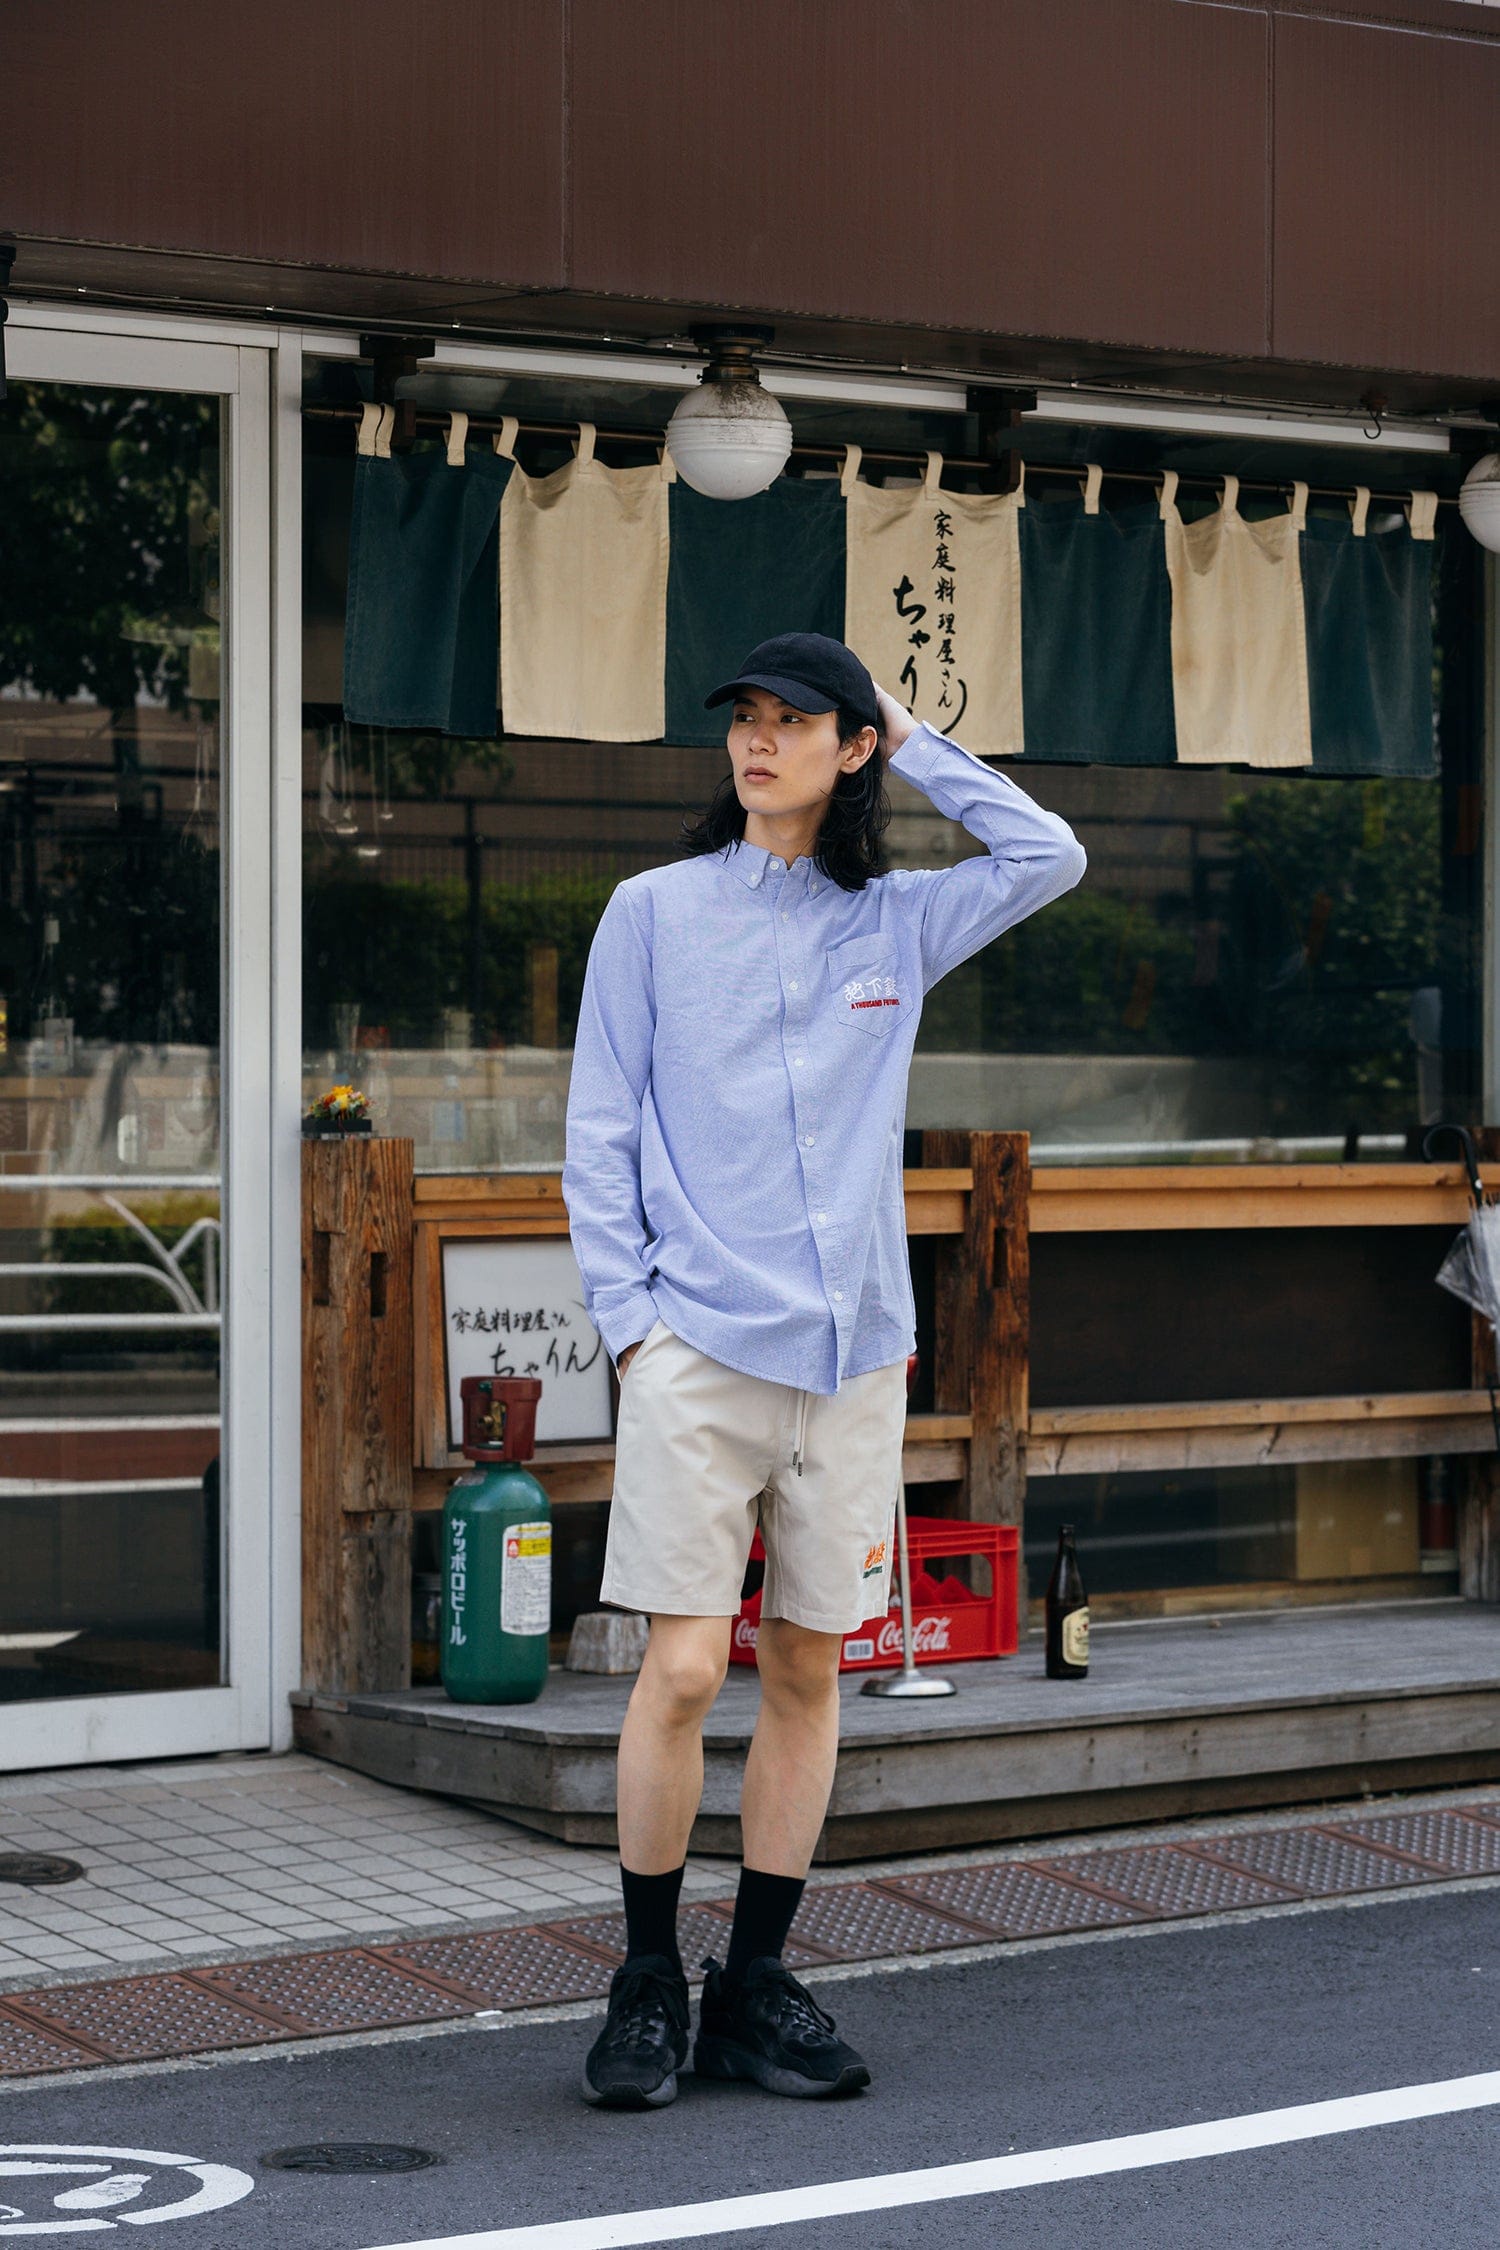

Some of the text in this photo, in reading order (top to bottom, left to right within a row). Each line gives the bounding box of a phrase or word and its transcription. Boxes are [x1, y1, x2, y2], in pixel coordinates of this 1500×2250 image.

[931, 508, 956, 708] 家庭料理屋さん
[452, 1307, 571, 1334] 家庭料理屋さん
[490, 1300, 602, 1379] ちゃりん
[450, 1517, 467, 1646] サッポロビール
[877, 1617, 952, 1655] CocCola
